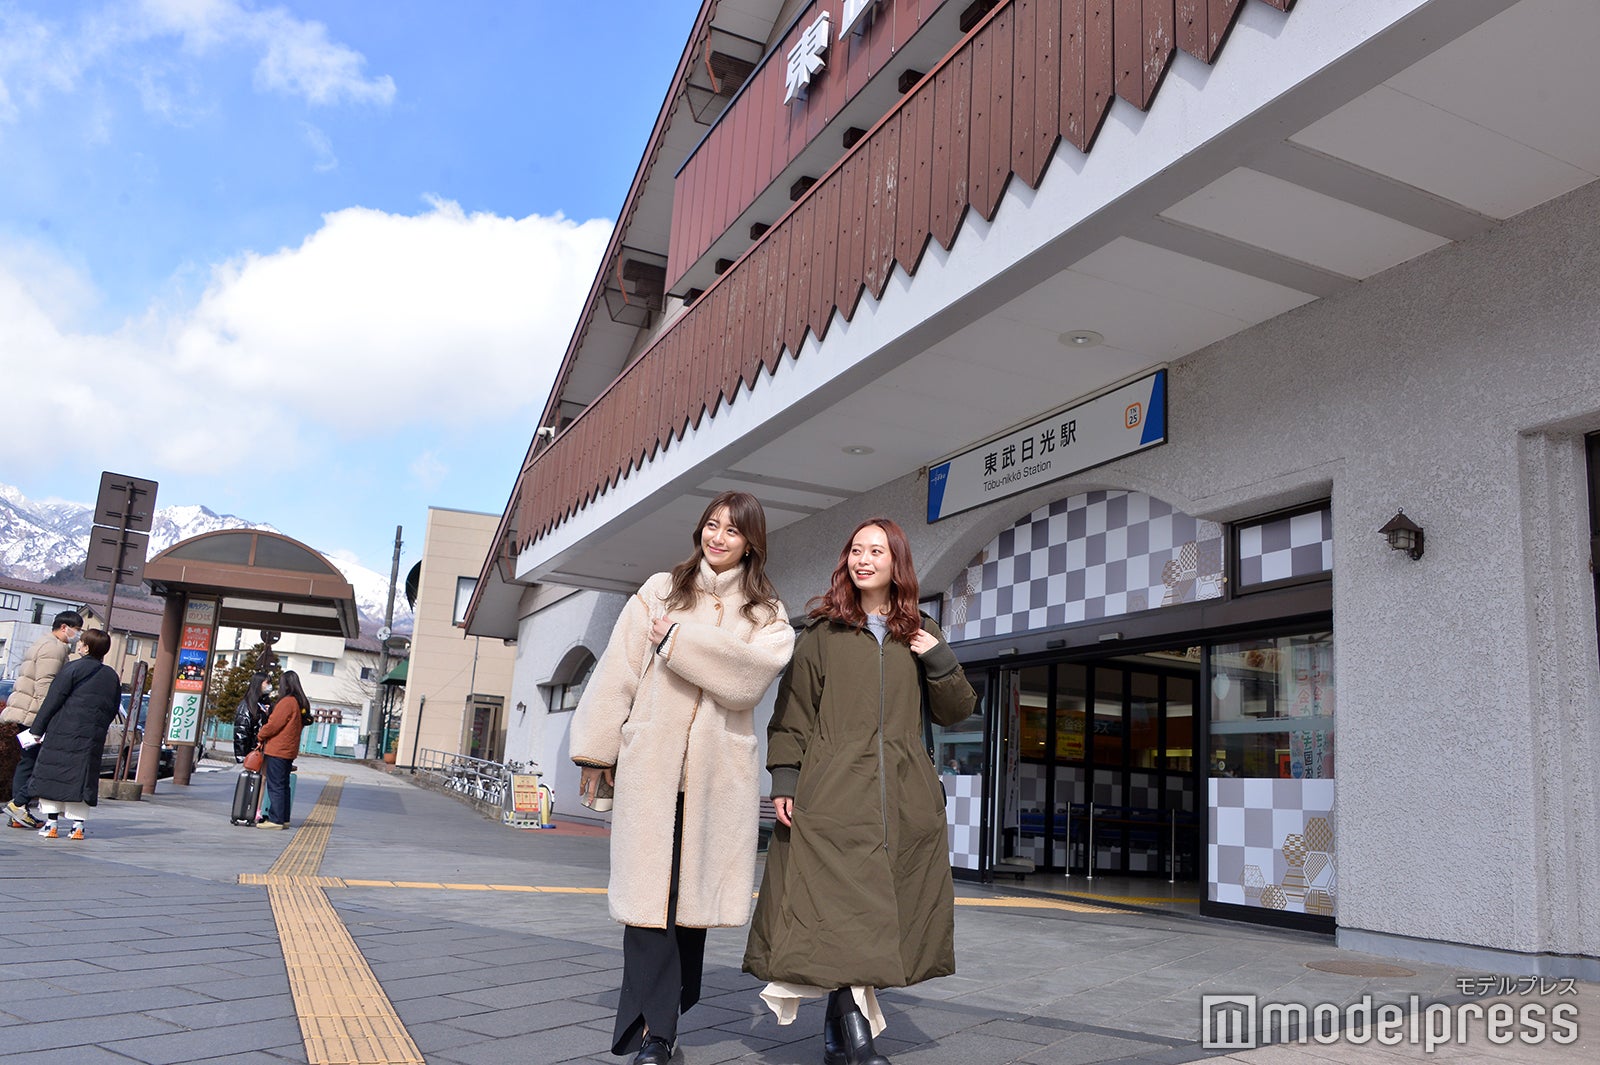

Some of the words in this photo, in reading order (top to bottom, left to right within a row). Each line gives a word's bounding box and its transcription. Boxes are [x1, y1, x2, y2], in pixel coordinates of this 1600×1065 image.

[1129, 406, 1138, 414] TN
[1129, 414, 1138, 425] 25
[983, 419, 1077, 477] 東武日光駅
[1023, 460, 1052, 478] Station
[170, 705, 184, 739] のりば
[184, 695, 198, 740] タクシー
